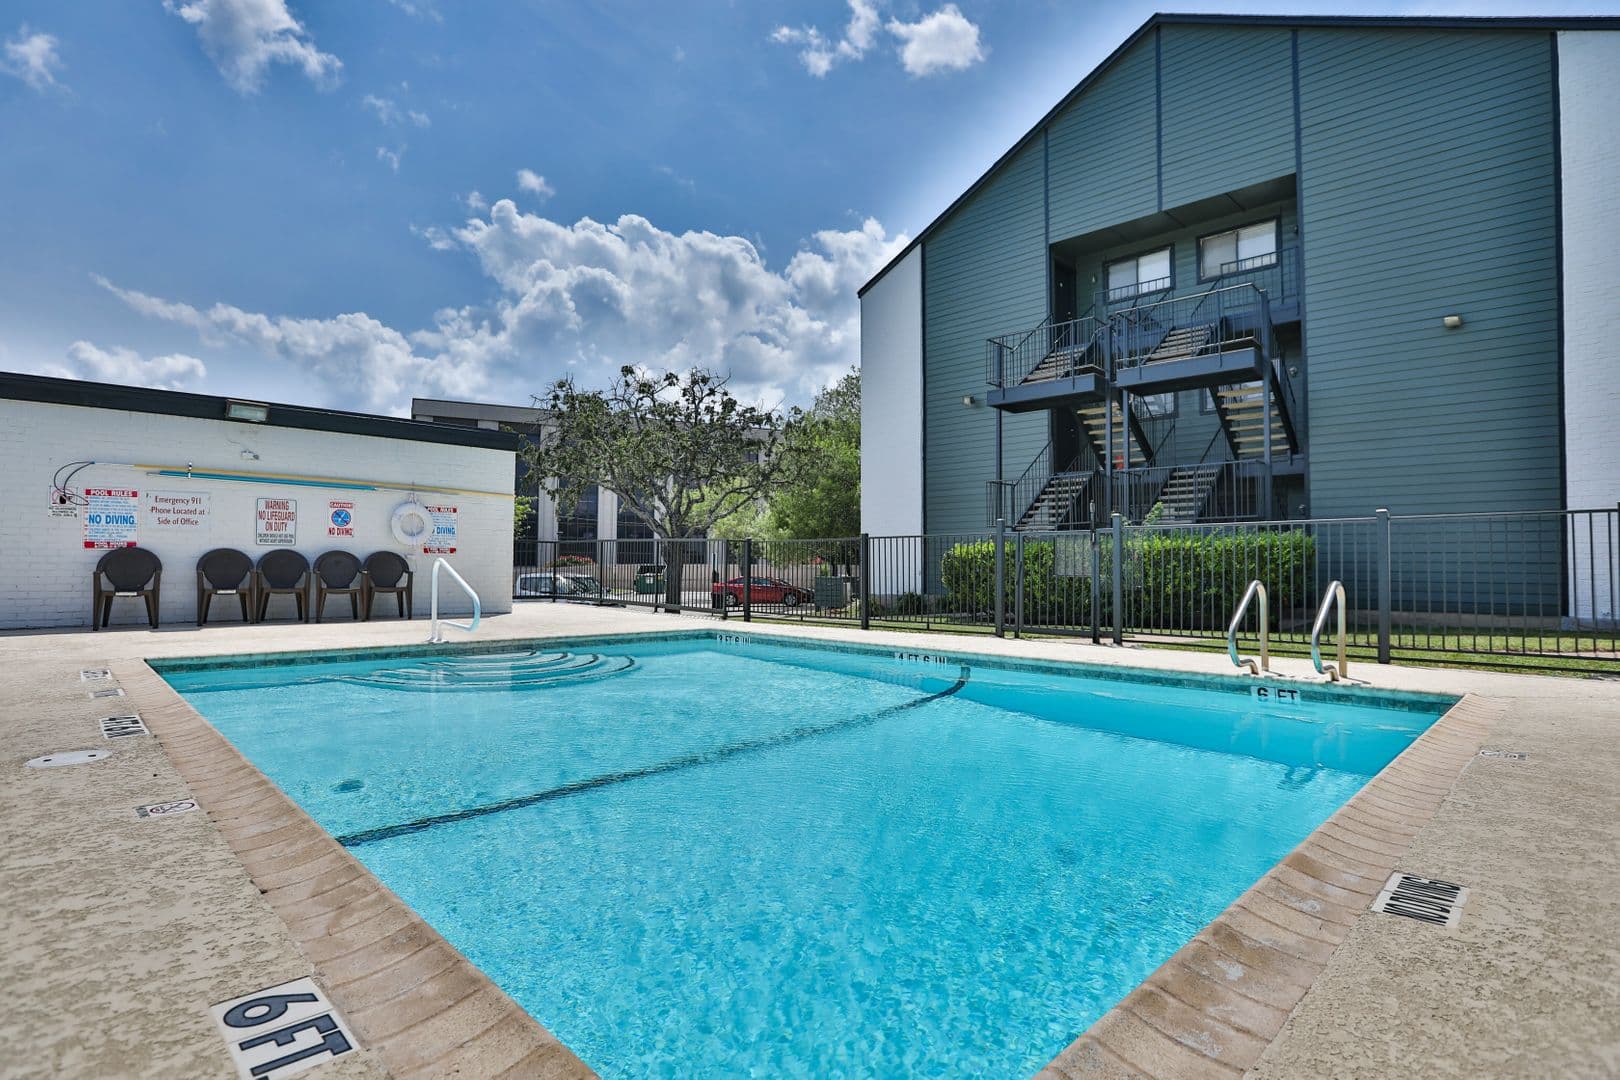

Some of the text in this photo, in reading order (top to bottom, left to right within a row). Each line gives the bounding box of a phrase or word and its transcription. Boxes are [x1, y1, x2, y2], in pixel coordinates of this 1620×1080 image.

[91, 489, 131, 497] POOL RULES
[155, 496, 189, 505] Emergency
[265, 500, 289, 511] WARNING
[151, 506, 171, 514] Phone
[172, 507, 197, 515] Located
[258, 510, 295, 521] NO LIFEGUARD
[88, 513, 102, 524] NO
[157, 517, 171, 525] Side
[172, 517, 179, 525] of
[265, 521, 288, 532] ON DUTY
[328, 527, 353, 537] NO DIVING
[1257, 687, 1298, 700] 6 FT
[1382, 876, 1461, 927] NO DIVING
[223, 992, 320, 1029] 6
